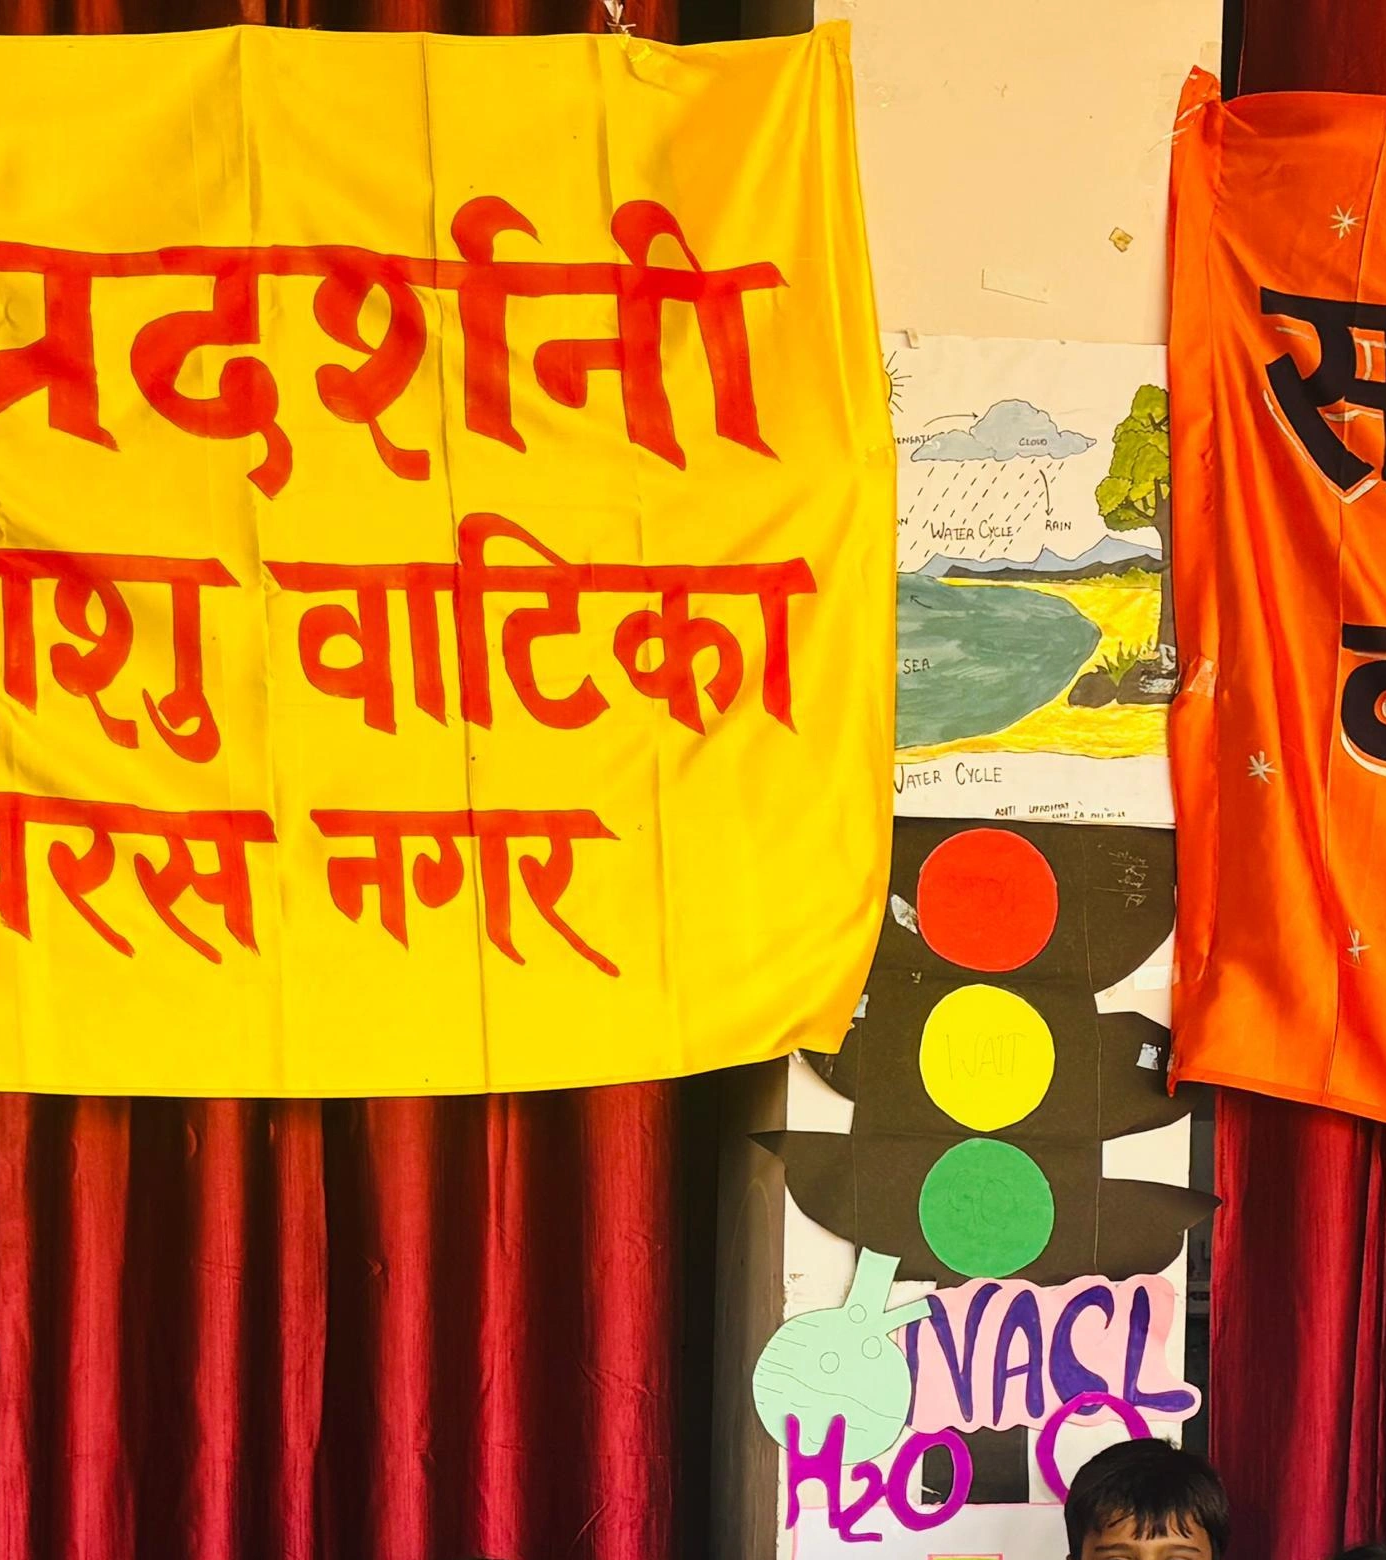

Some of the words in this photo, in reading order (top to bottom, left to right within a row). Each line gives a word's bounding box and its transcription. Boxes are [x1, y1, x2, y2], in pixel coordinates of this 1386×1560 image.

[930, 521, 974, 541] WATER
[978, 519, 1014, 540] CYCLE
[1045, 520, 1072, 532] RAIN
[263, 512, 817, 737] वाटिका
[902, 657, 931, 674] SEA
[955, 761, 1004, 786] CYCLE
[314, 808, 621, 978] नगर
[785, 1413, 973, 1543] H2O
